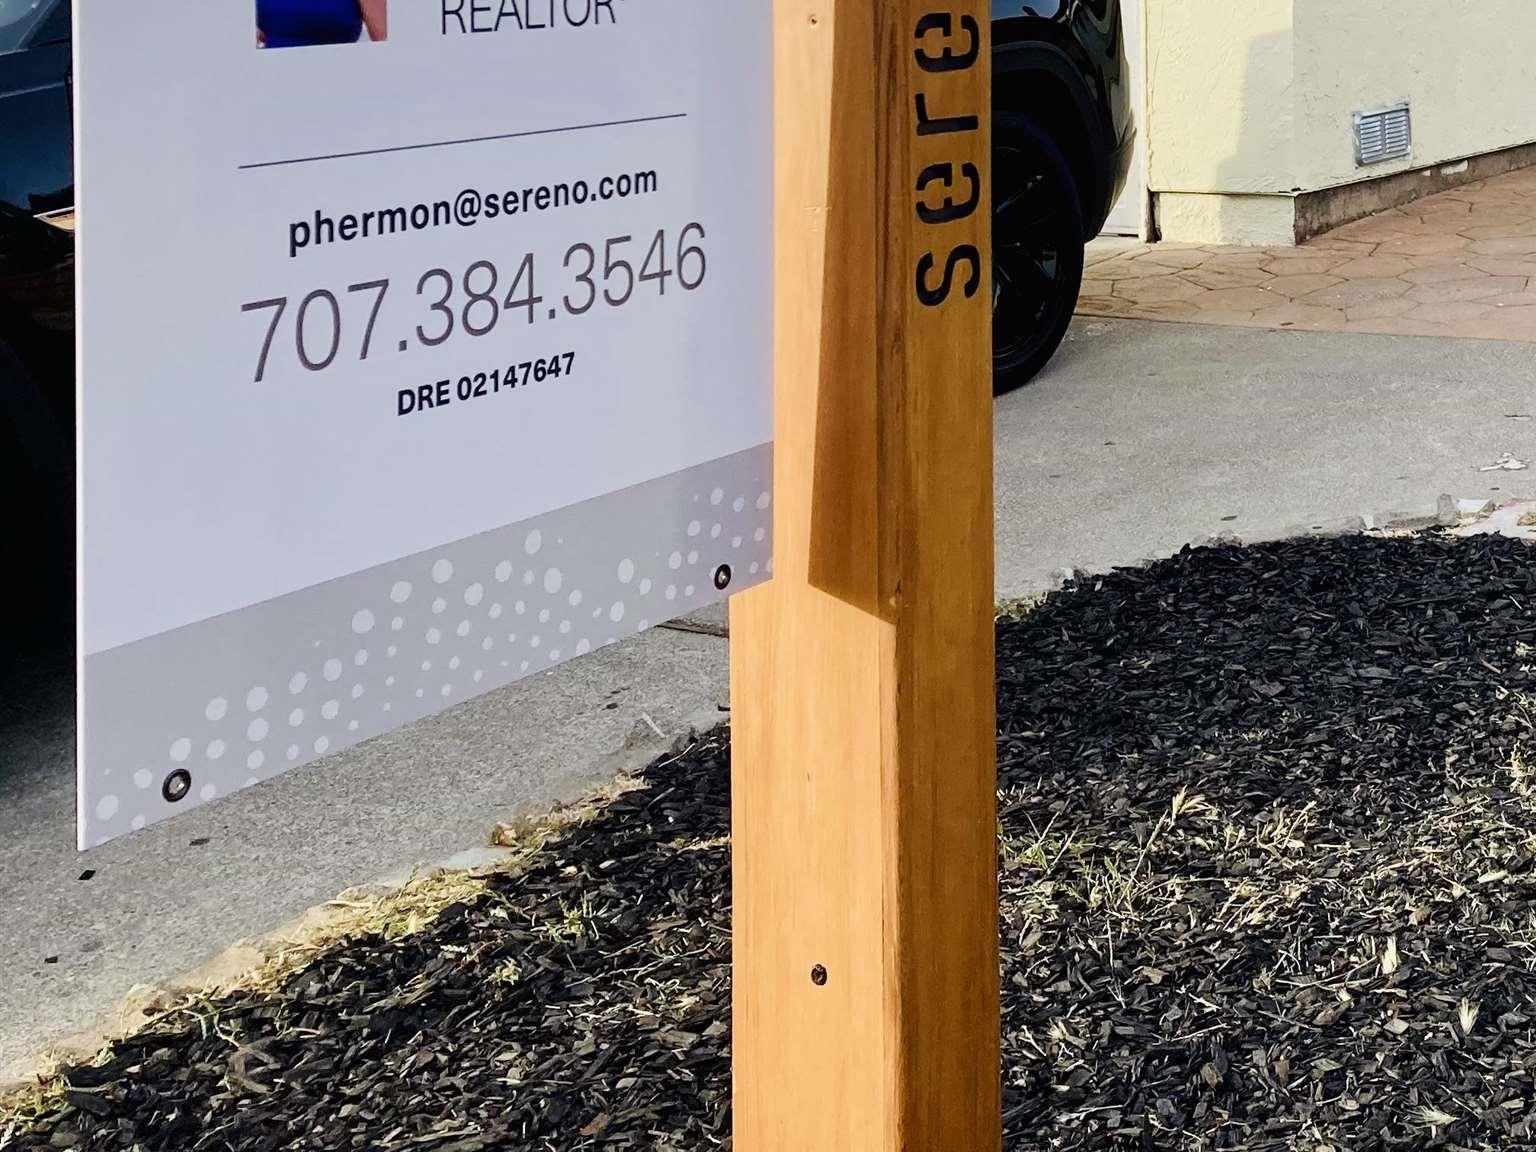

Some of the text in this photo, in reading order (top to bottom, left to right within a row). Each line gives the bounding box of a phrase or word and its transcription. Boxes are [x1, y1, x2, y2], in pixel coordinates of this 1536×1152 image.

[289, 169, 658, 258] phermon@sereno.com
[240, 221, 708, 384] 707.384.3546
[396, 351, 577, 417] DRE 02147647
